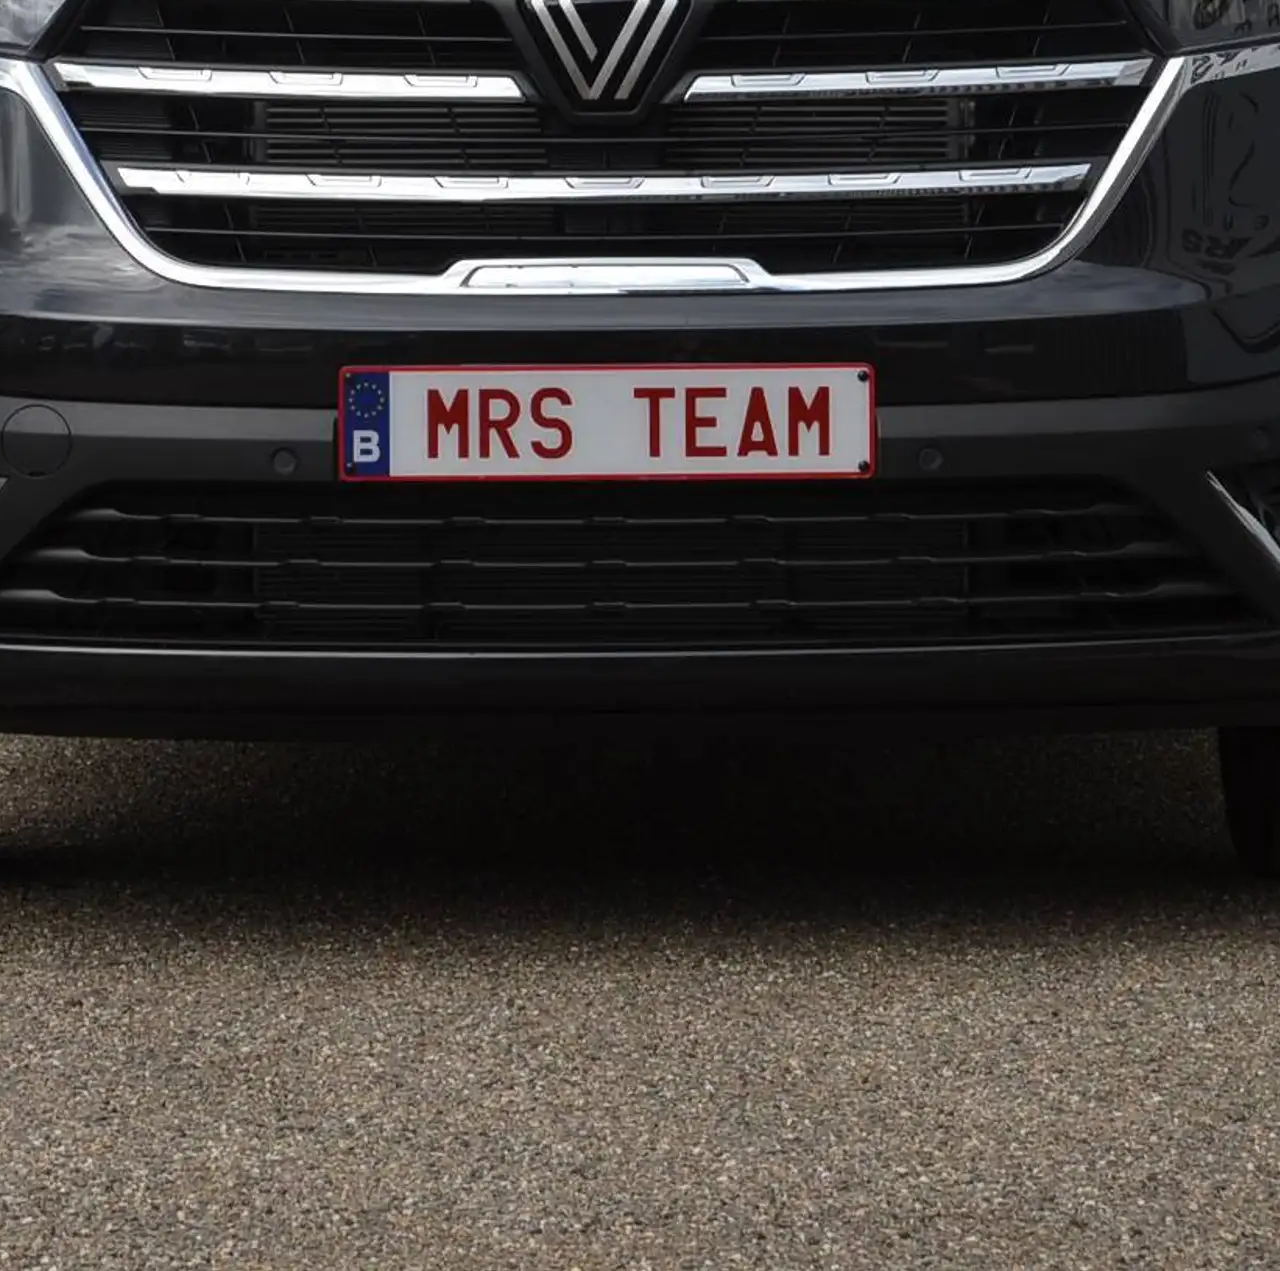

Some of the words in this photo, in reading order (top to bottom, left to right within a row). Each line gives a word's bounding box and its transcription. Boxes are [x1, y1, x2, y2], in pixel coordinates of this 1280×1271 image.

[353, 430, 381, 463] B
[427, 388, 573, 459] MRS
[633, 386, 830, 457] TEAM
